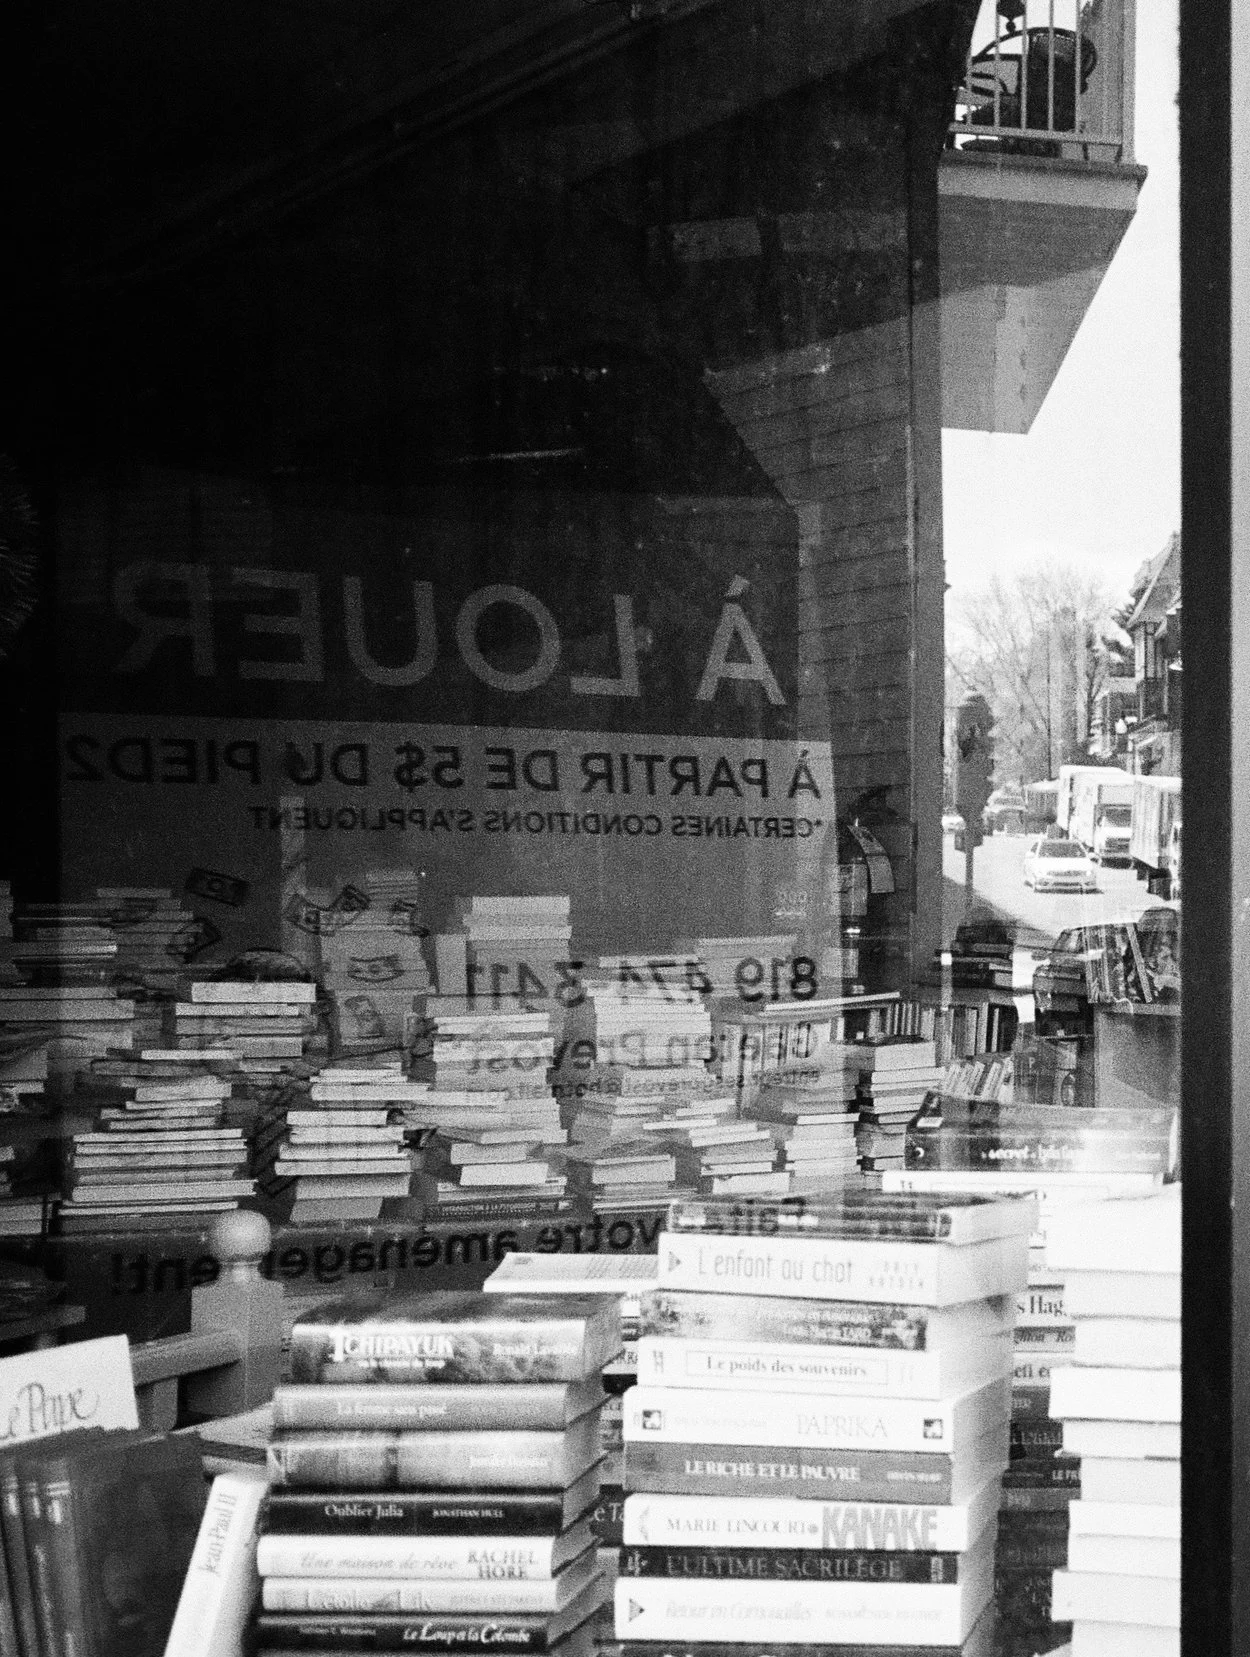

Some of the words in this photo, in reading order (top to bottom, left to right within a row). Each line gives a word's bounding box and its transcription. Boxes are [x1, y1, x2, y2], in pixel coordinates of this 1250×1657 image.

[782, 1258, 803, 1281] au
[812, 1254, 853, 1284] chat
[706, 1354, 726, 1370] Le
[729, 1355, 767, 1375] poids
[770, 1357, 795, 1373] des
[798, 1361, 867, 1378] souvenirs
[795, 1413, 889, 1439] PAPRIKA
[324, 1503, 373, 1519] Oublier
[375, 1503, 405, 1521] Julia
[667, 1517, 720, 1533] MARIE
[821, 1505, 938, 1549] KANAKE
[467, 1549, 538, 1565] RACHEL
[666, 1555, 769, 1578] L'ULTIME
[477, 1565, 528, 1580] HORE
